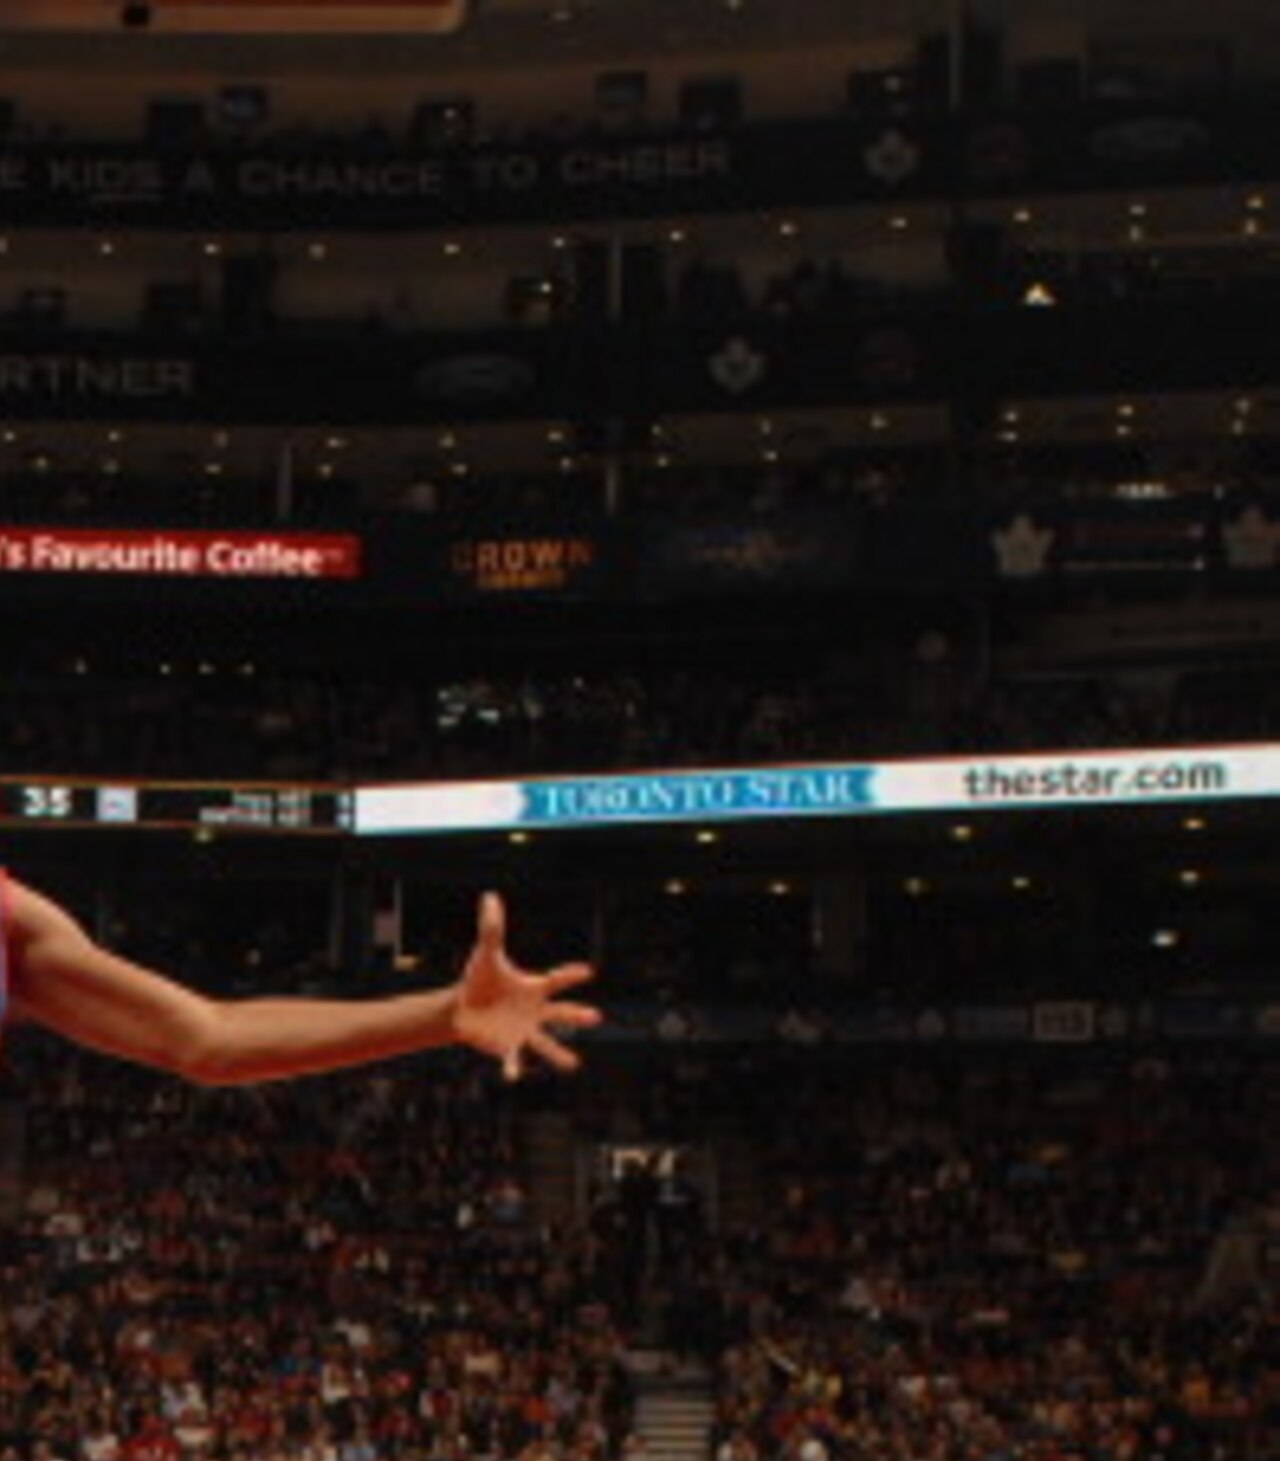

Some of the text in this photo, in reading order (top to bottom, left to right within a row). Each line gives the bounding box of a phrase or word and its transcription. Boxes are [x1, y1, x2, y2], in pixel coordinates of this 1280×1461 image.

[48, 158, 161, 190] KIDS
[184, 159, 215, 194] A
[239, 159, 441, 196] CHANCE
[470, 156, 538, 191] TO
[559, 142, 730, 183] CHEER
[31, 536, 200, 574] Favourite
[206, 541, 324, 577] Coffee
[547, 774, 853, 815] TORONTO STAR
[963, 761, 1226, 796] thestar.com
